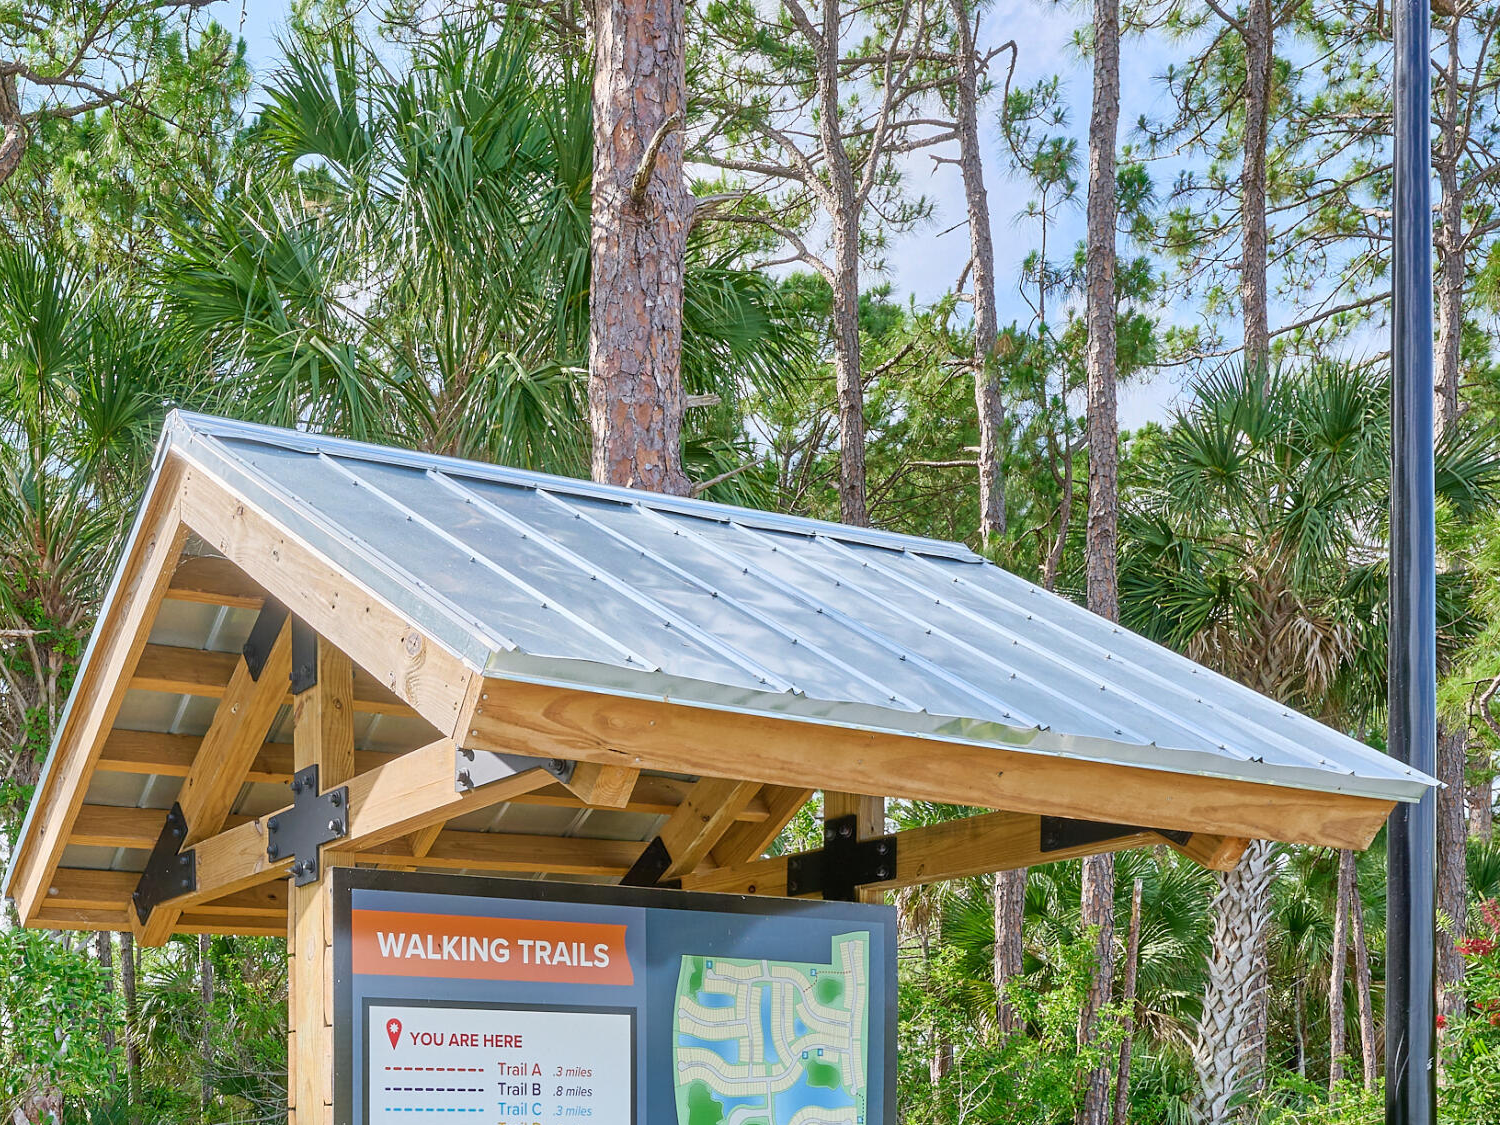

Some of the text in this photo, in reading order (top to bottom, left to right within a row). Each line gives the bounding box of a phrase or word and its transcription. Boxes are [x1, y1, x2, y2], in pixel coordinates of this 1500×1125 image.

[377, 932, 610, 967] WALKING TRAILS
[410, 1032, 522, 1048] YOU ARE HERE
[498, 1062, 527, 1076] Trail
[531, 1063, 542, 1076] A
[565, 1067, 592, 1078] miles
[498, 1082, 527, 1096] Trail
[533, 1084, 541, 1096] B
[565, 1086, 592, 1097] miles
[498, 1102, 527, 1116] Trail
[532, 1103, 542, 1116] C
[565, 1106, 592, 1117] miles
